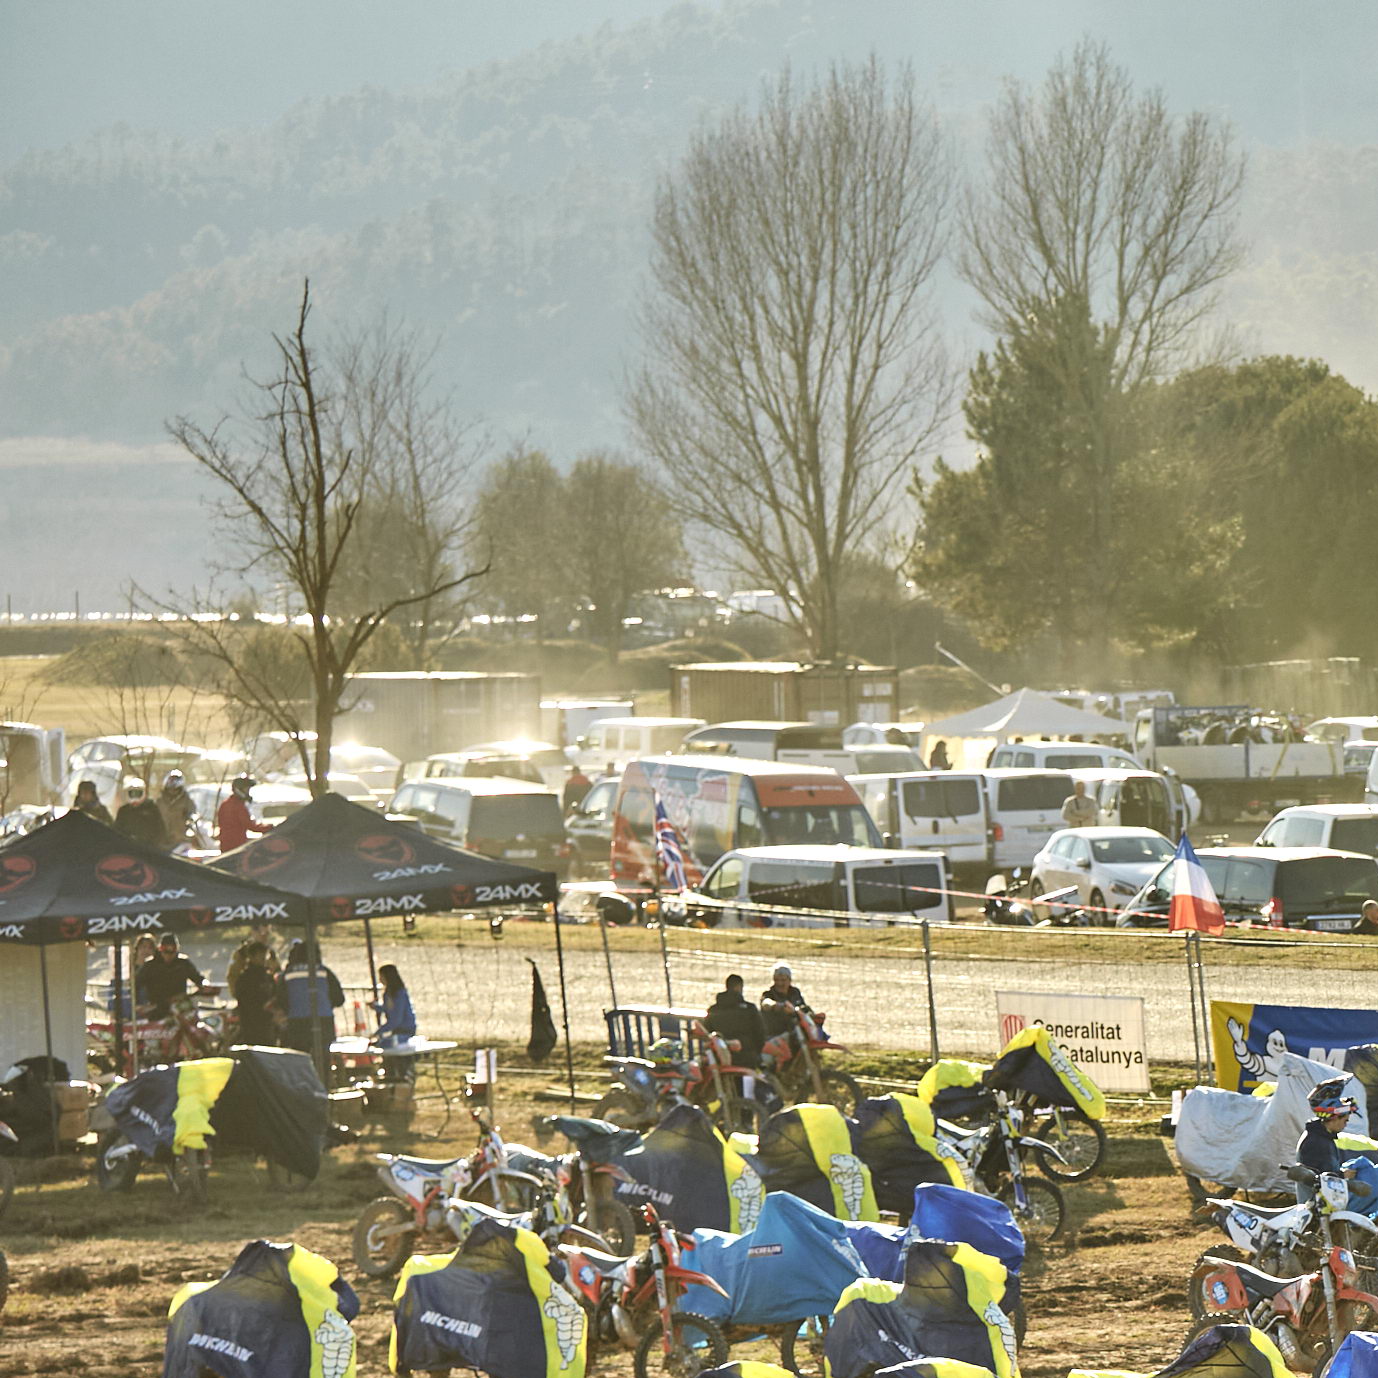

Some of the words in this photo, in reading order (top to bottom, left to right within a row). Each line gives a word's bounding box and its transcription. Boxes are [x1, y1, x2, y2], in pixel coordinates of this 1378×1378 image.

[372, 862, 453, 882] 24MX
[110, 886, 195, 907] 24MX
[475, 882, 542, 903] 24MX
[215, 901, 289, 923] 24MX
[355, 894, 427, 915] 24MX
[86, 911, 164, 935] 24MX
